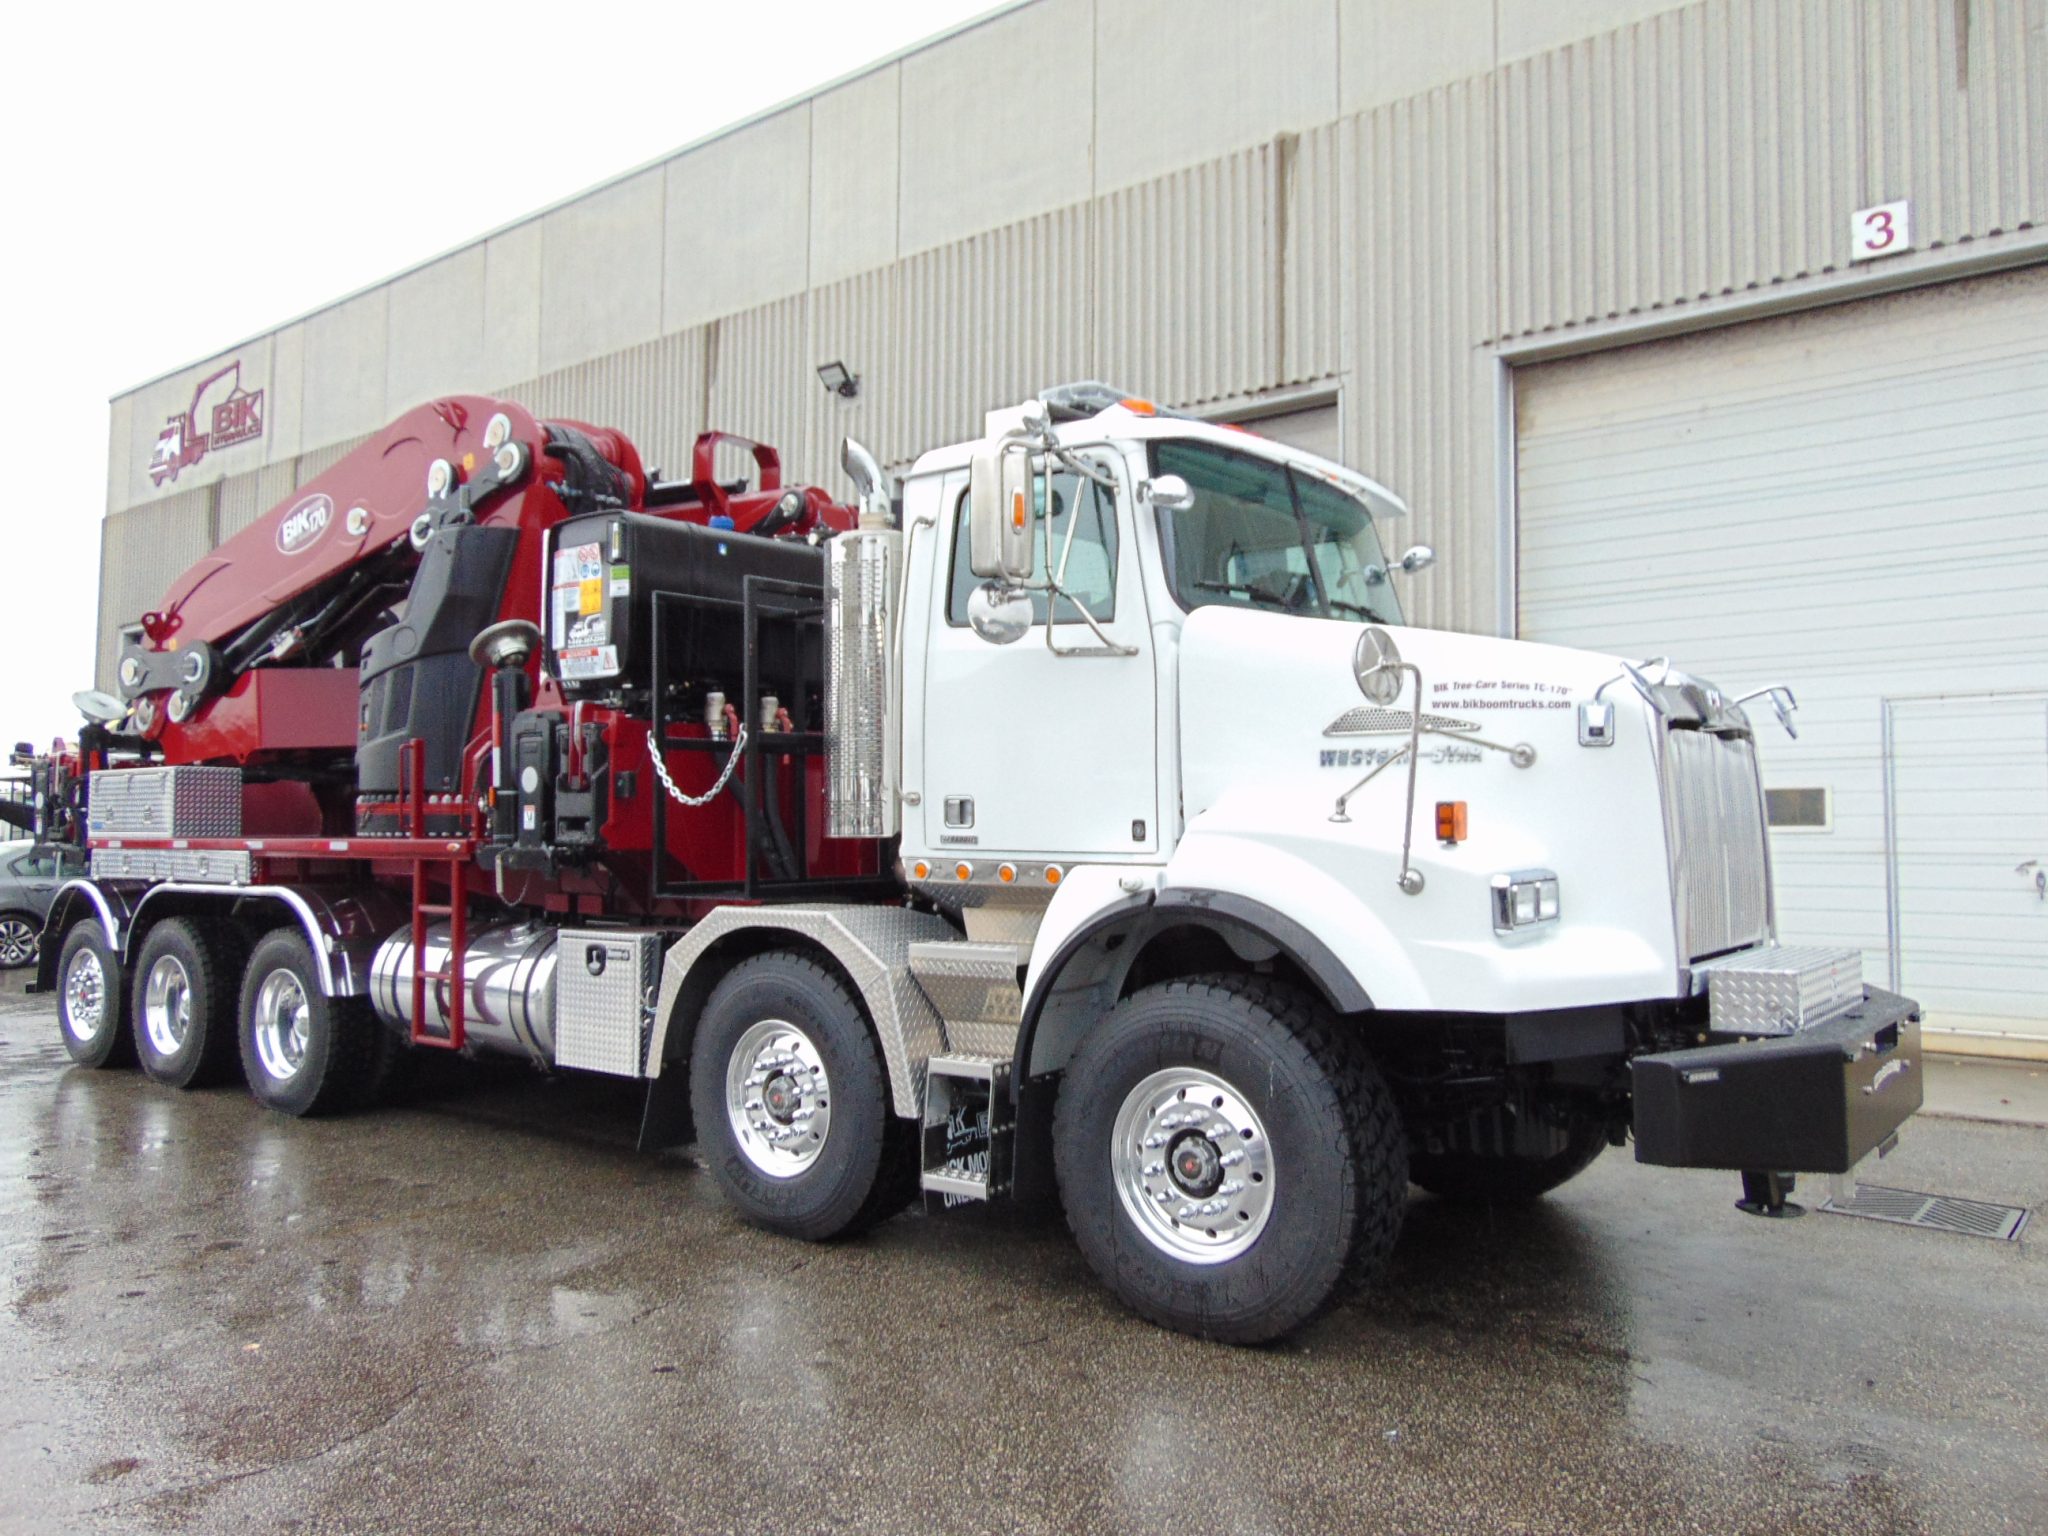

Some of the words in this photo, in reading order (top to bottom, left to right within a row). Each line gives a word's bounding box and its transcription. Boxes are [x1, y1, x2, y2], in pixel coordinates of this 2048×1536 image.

[1864, 211, 1895, 250] 3
[214, 394, 261, 435] BIK
[282, 507, 310, 546] BIK
[1431, 699, 1572, 710] www.bikboomtrucks.com
[1433, 682, 1449, 693] BIK
[1452, 680, 1498, 691] Tree-Care
[1501, 680, 1530, 691] Series
